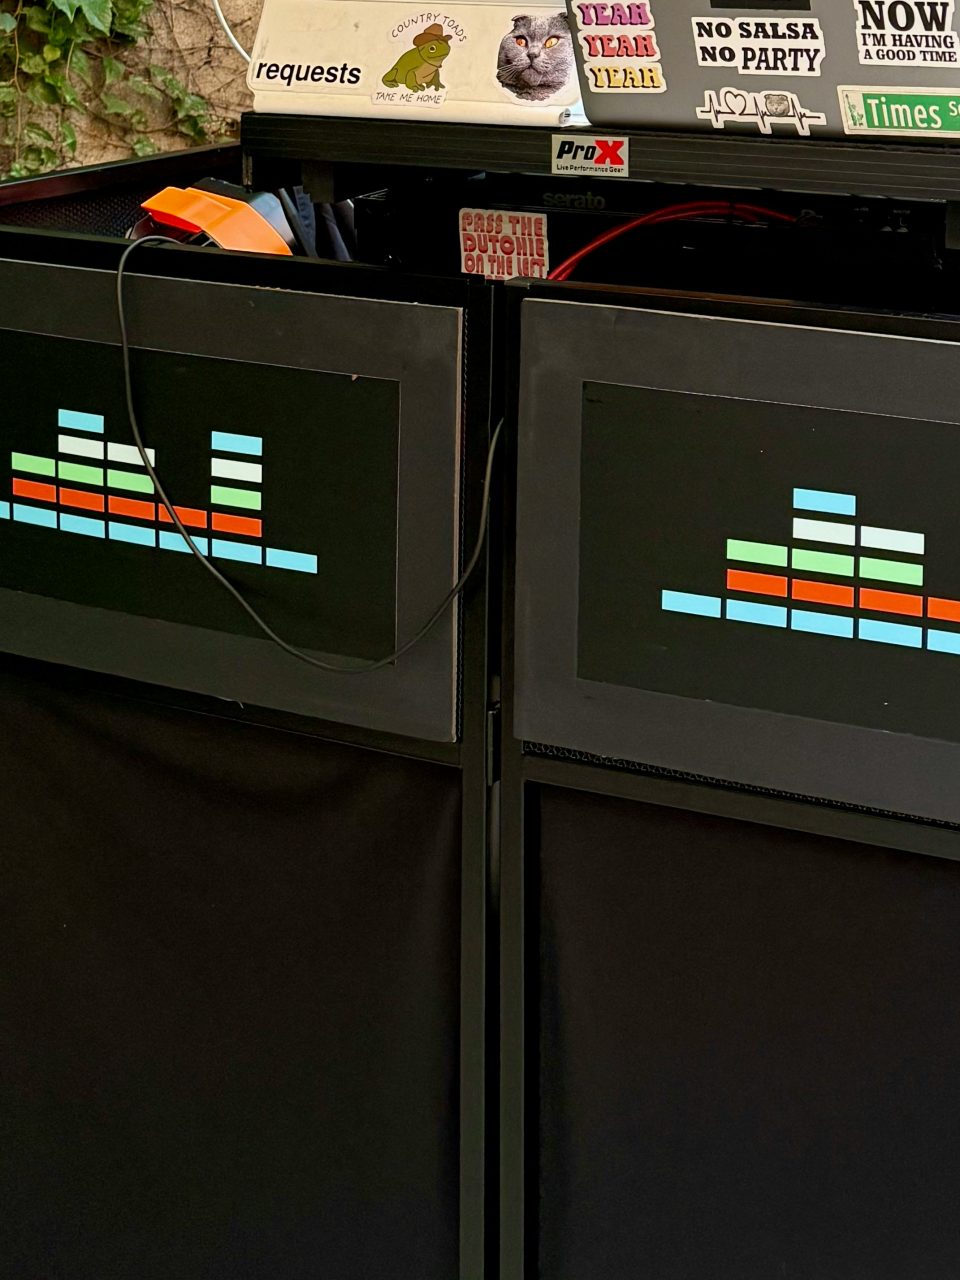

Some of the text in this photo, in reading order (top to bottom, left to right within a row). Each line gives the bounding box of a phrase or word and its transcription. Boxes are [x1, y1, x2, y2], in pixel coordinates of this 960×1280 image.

[577, 2, 651, 25] YEAH
[858, 0, 949, 32] NOW
[391, 12, 467, 42] COUNTRY TOADS
[695, 22, 819, 40] NO SALSA
[583, 34, 657, 57] YEAH
[861, 33, 955, 49] I'M HAVING
[700, 46, 821, 72] NO PARTY
[863, 49, 957, 62] A GOOD TIME
[256, 62, 361, 87] requests
[589, 66, 663, 88] YEAH
[376, 91, 442, 104] TAKE ME HOME
[867, 96, 942, 129] Times
[556, 140, 625, 166] ProX
[570, 165, 608, 173] Performance
[543, 191, 606, 210] serato
[461, 212, 543, 237] PASS THE
[464, 253, 545, 278] ON THE LEFT
